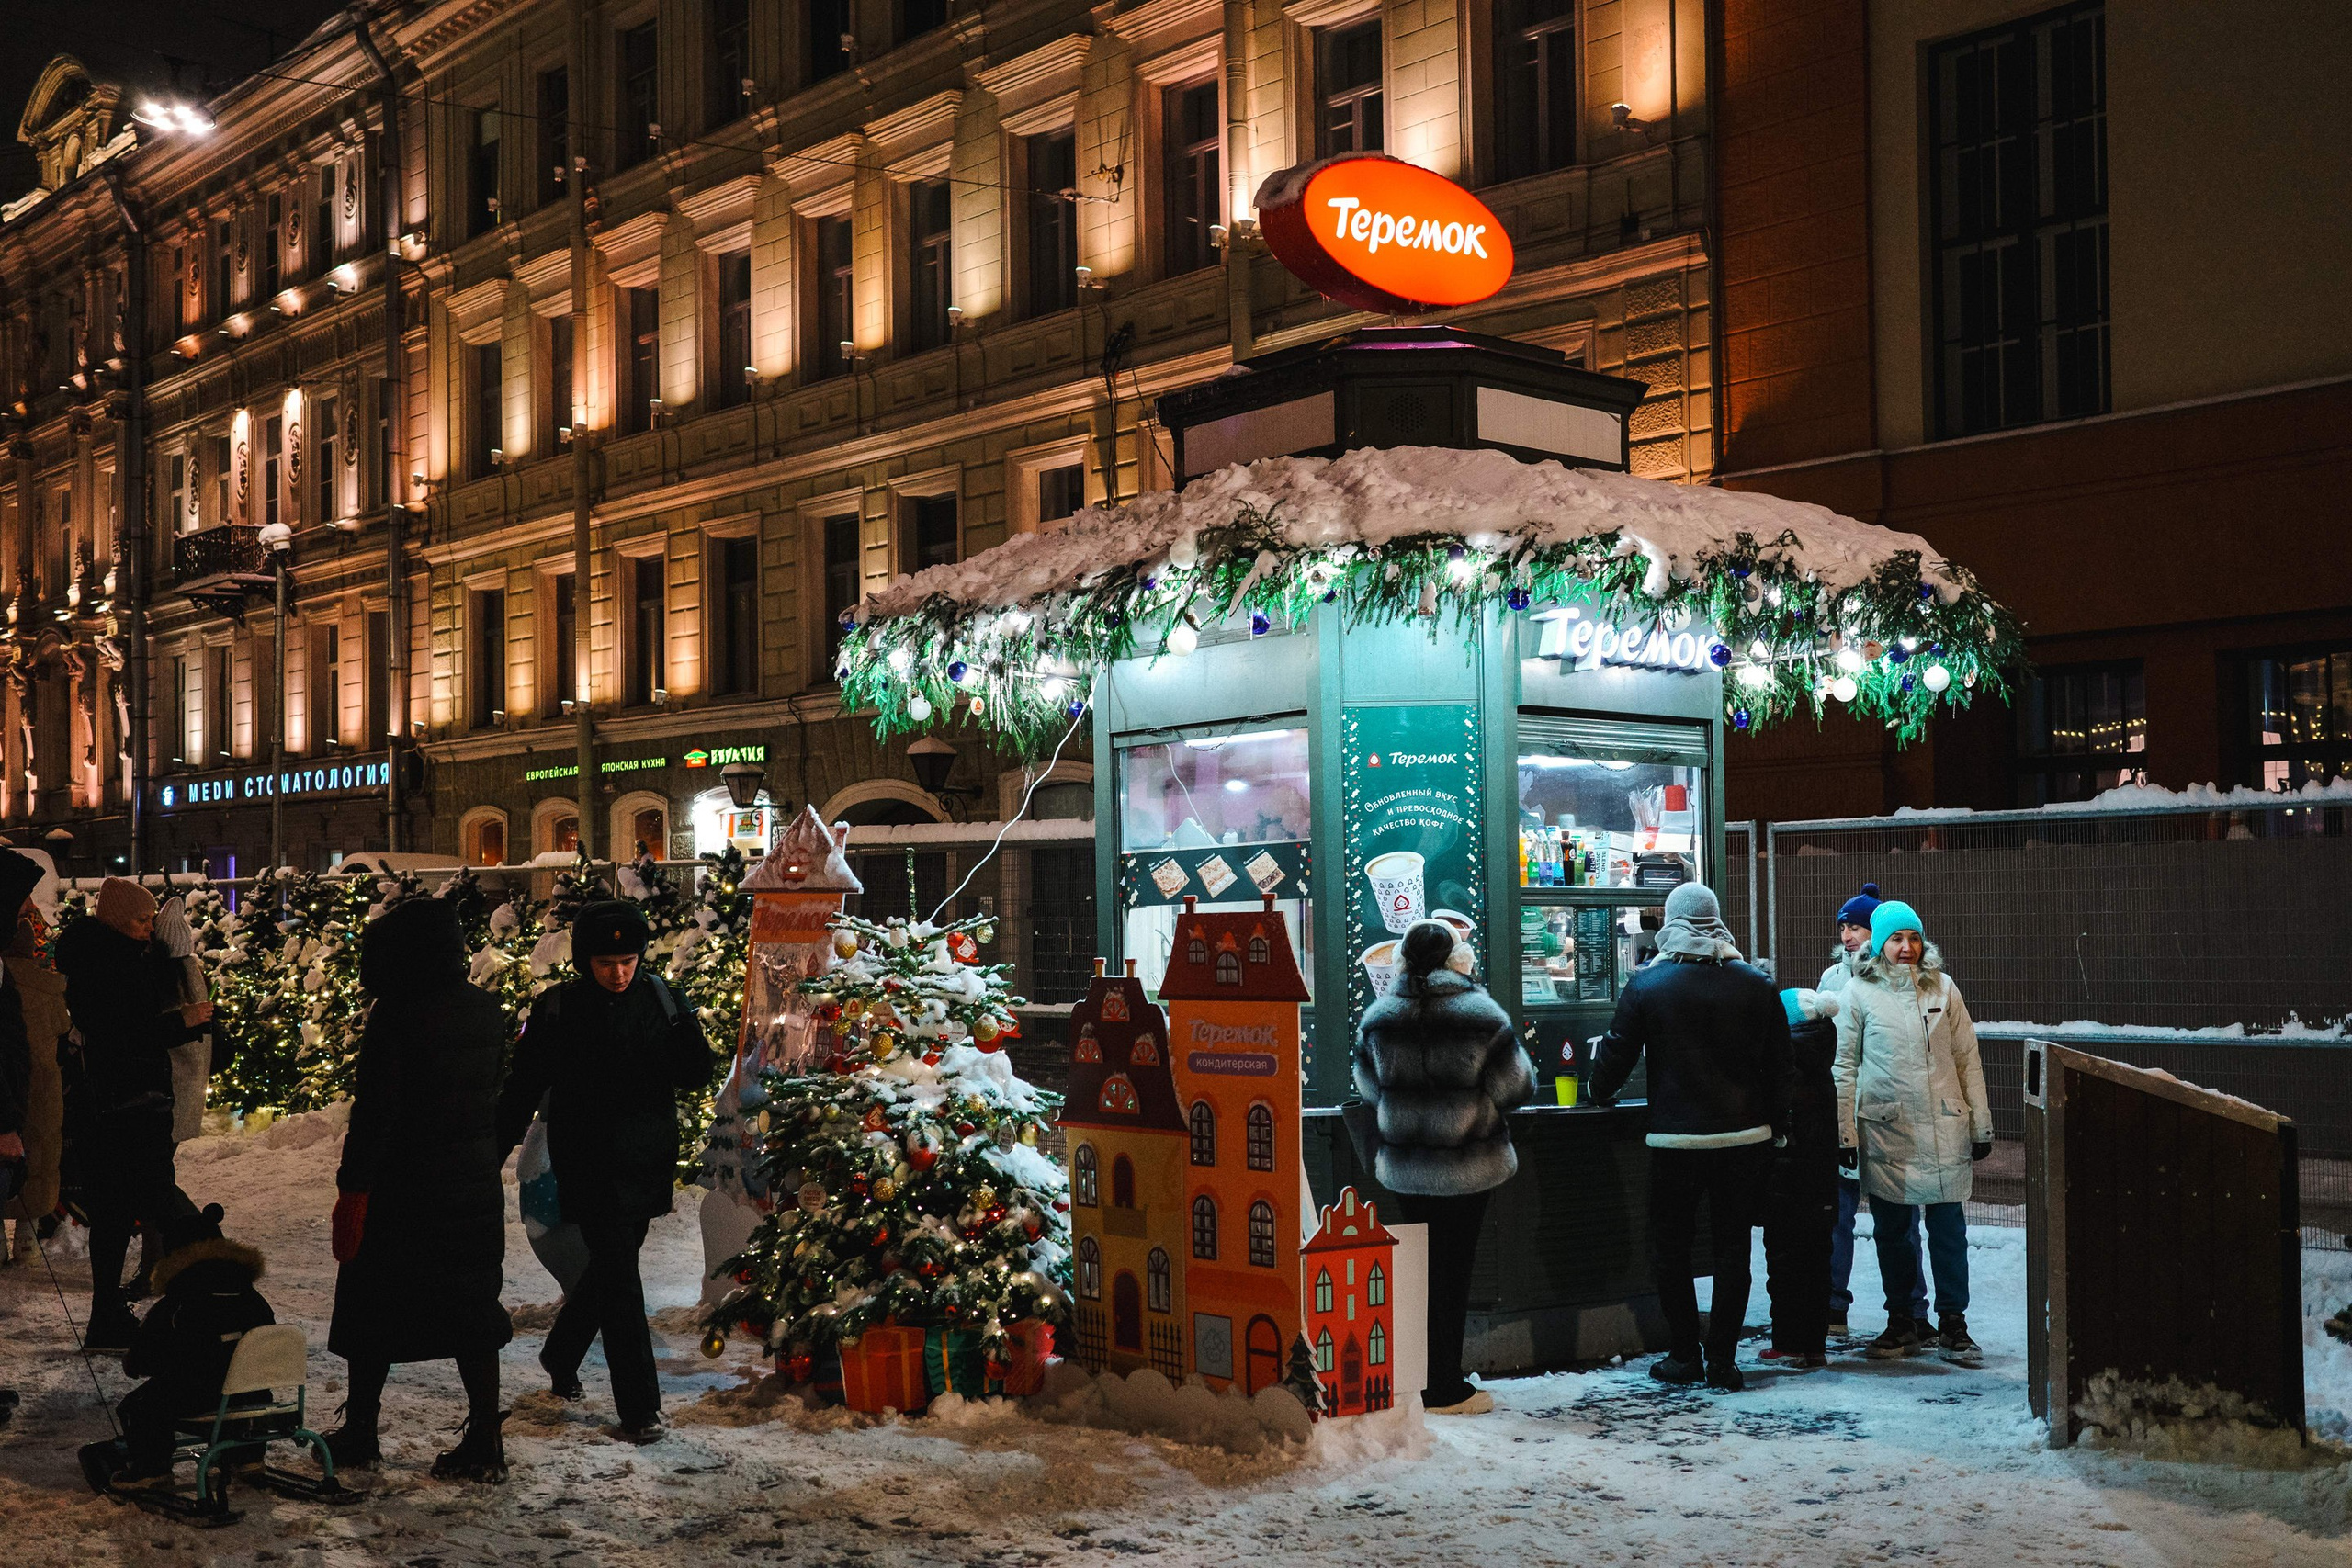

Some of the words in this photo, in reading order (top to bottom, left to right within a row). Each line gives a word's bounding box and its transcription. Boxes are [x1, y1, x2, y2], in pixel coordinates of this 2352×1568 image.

[1327, 197, 1488, 259] Теремок
[1532, 607, 1723, 672] Теремок
[601, 760, 639, 773] ЯПОНСКАЯ
[641, 757, 666, 769] КУХНЯ
[1388, 751, 1458, 768] Теремок
[526, 765, 579, 781] ЕВРОПЕЙСКАЯ
[1435, 791, 1458, 804] ВКУС
[1386, 807, 1394, 816] И
[1396, 805, 1464, 825] ПРЕВОСХОДНОЕ
[1372, 818, 1417, 836] КАЧЕСТВО
[1419, 818, 1445, 829] КОФЕ
[1187, 1019, 1279, 1048] Теремок
[1195, 1057, 1268, 1071] кондитерская
